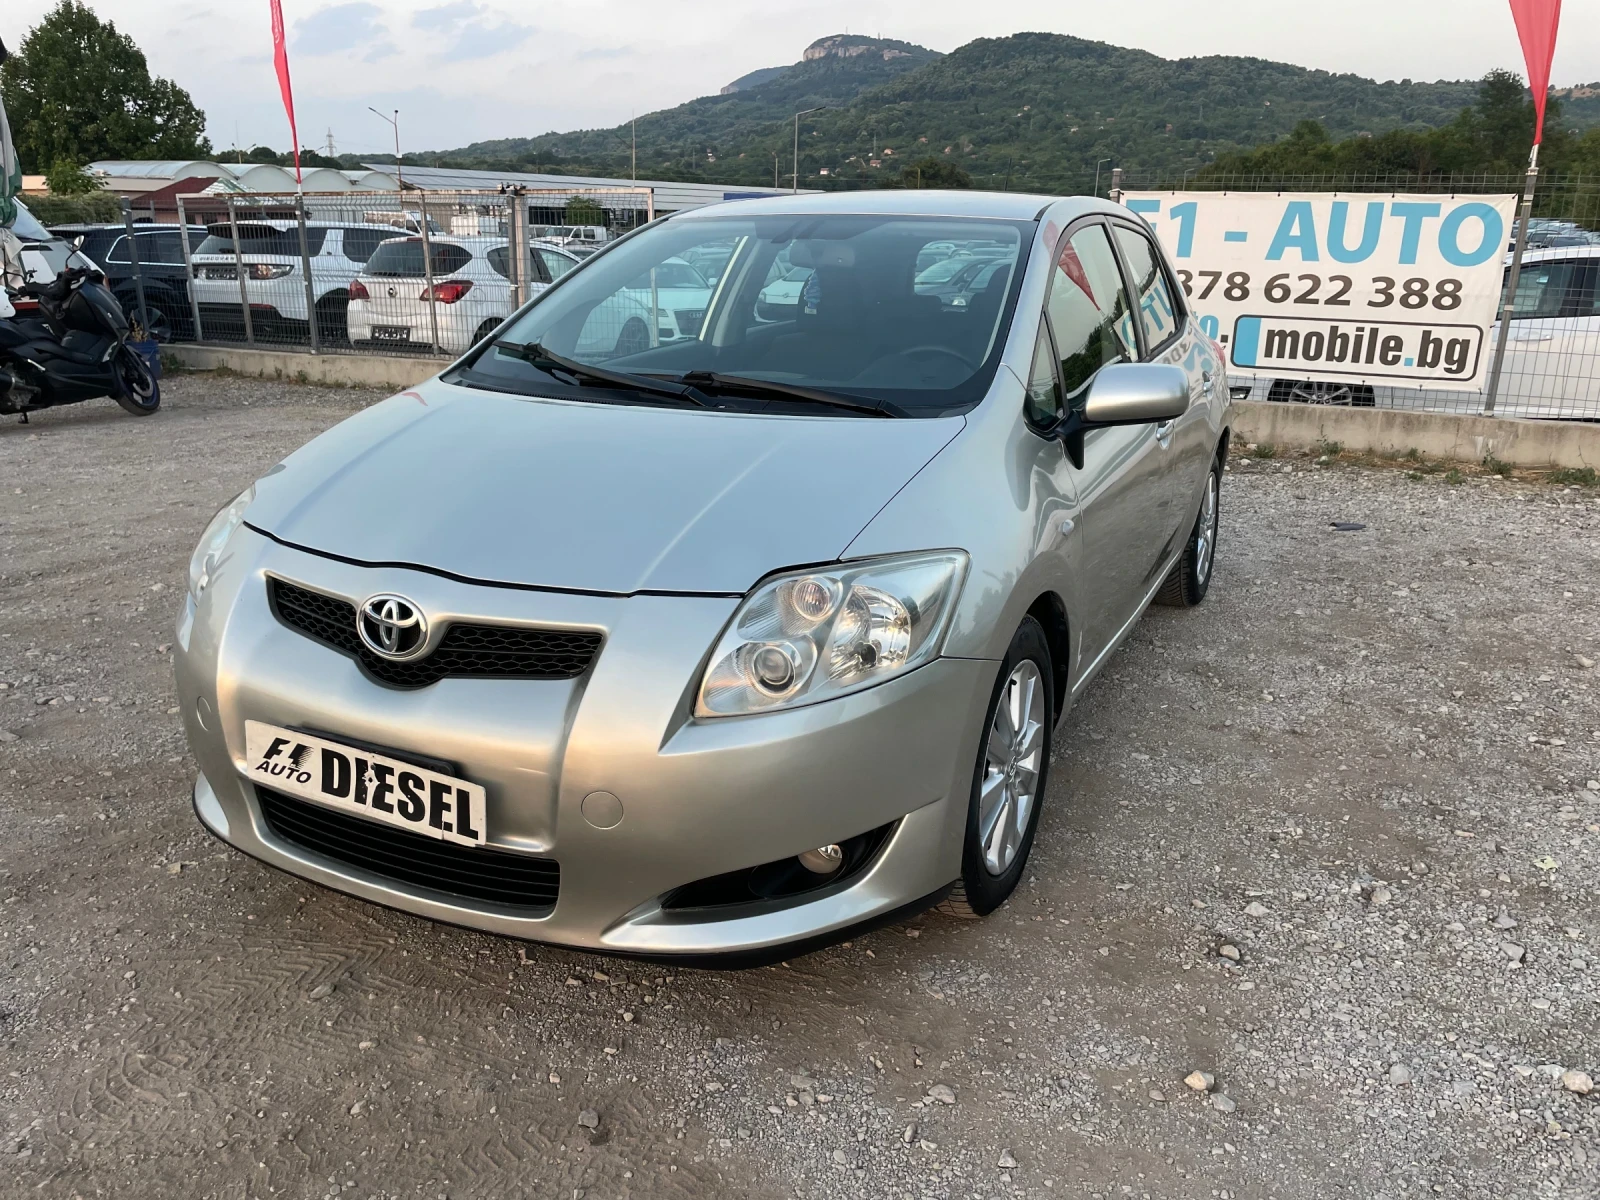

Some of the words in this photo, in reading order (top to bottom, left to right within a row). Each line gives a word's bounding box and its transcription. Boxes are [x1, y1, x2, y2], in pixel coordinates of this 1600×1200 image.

[1264, 201, 1504, 267] AUTO
[1263, 273, 1353, 306] 622
[1366, 276, 1463, 311] 388
[1263, 325, 1471, 374] mobile.bg
[255, 760, 312, 784] AUTO
[321, 747, 479, 840] DIESEL
